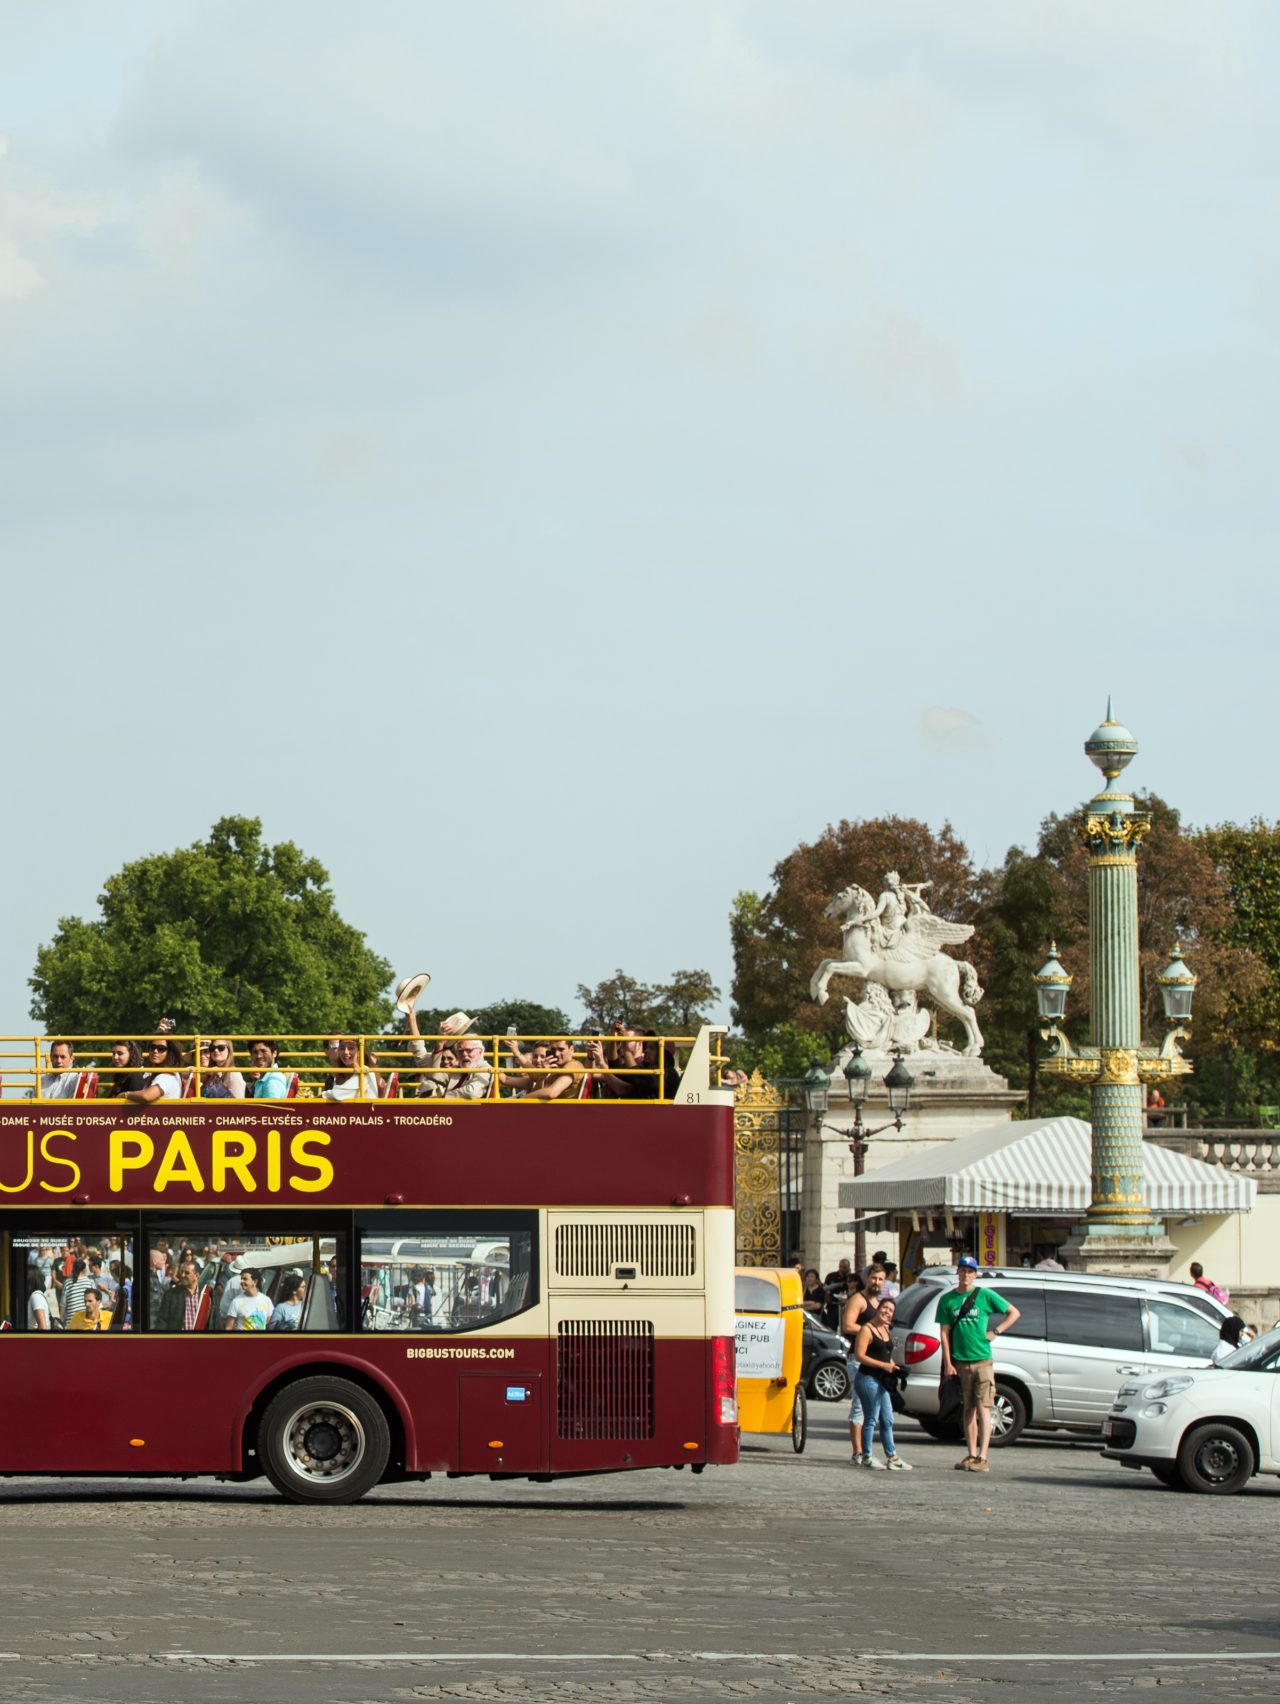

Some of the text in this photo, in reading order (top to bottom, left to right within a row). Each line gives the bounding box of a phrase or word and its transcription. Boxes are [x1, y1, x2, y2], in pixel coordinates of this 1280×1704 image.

[686, 1093, 700, 1103] 81
[40, 1115, 73, 1126] MUSÉE
[76, 1117, 117, 1126] D'ORSAY
[127, 1115, 159, 1126] OPÉRA
[162, 1117, 205, 1126] GARNIER
[216, 1115, 303, 1126] CHAMPS-ELYSÉES
[312, 1117, 347, 1126] GRAND
[349, 1117, 384, 1126] PALAIS
[394, 1115, 453, 1126] TROCADÉRO
[109, 1129, 334, 1193] PARIS
[735, 1321, 766, 1329] GINEZ
[406, 1348, 515, 1359] BIGBUSTOURS.COM
